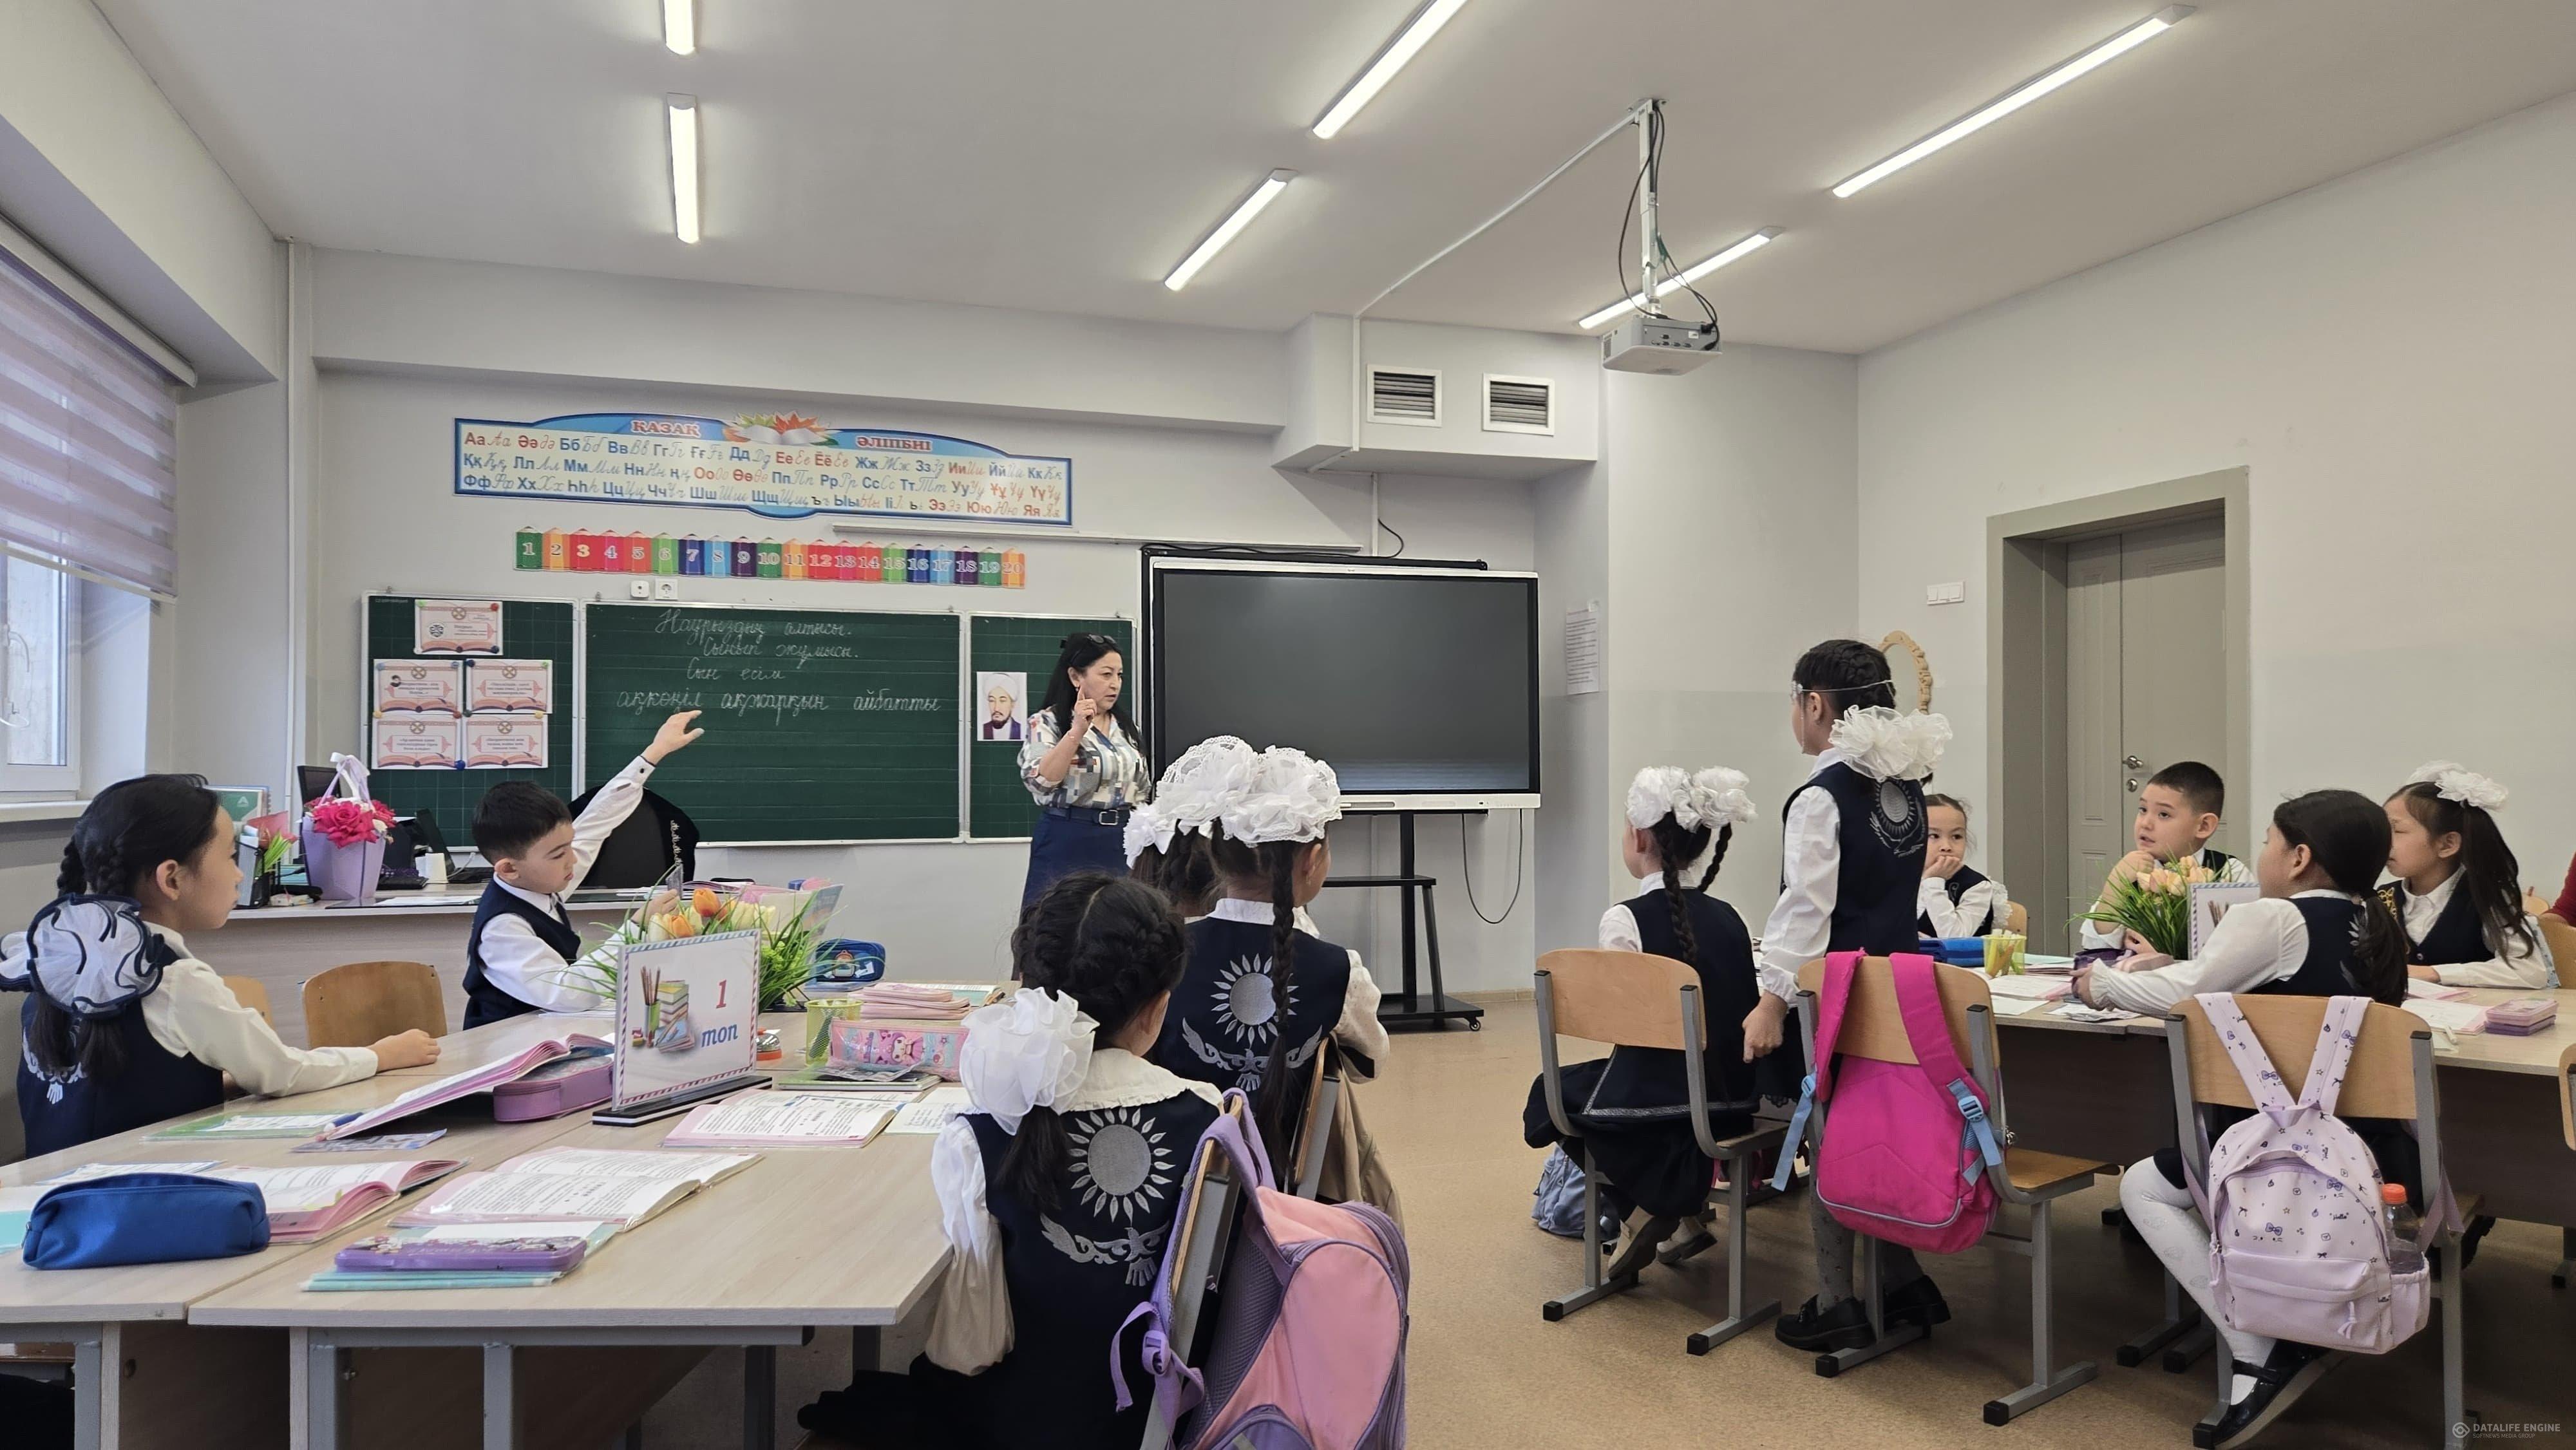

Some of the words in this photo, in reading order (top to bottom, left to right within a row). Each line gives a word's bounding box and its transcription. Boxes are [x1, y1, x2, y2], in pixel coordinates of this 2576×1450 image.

[523, 542, 533, 555] 1
[551, 545, 561, 555] 2
[576, 545, 590, 558] 3
[604, 545, 618, 558] 4
[631, 547, 645, 560] 5
[659, 548, 670, 560] 6
[687, 549, 699, 562] 7
[712, 549, 723, 562] 8
[737, 551, 750, 564] 9
[758, 552, 780, 565] 10
[785, 554, 806, 566] 11
[809, 554, 831, 567] 12
[834, 556, 856, 568] 13
[858, 556, 880, 569] 14
[884, 558, 905, 570] 15
[907, 558, 929, 570] 16
[933, 560, 952, 571] 17
[956, 561, 977, 572] 18
[980, 561, 1000, 573] 19
[1003, 563, 1022, 574] 20
[687, 657, 721, 680] Сын
[716, 979, 727, 1008] 1
